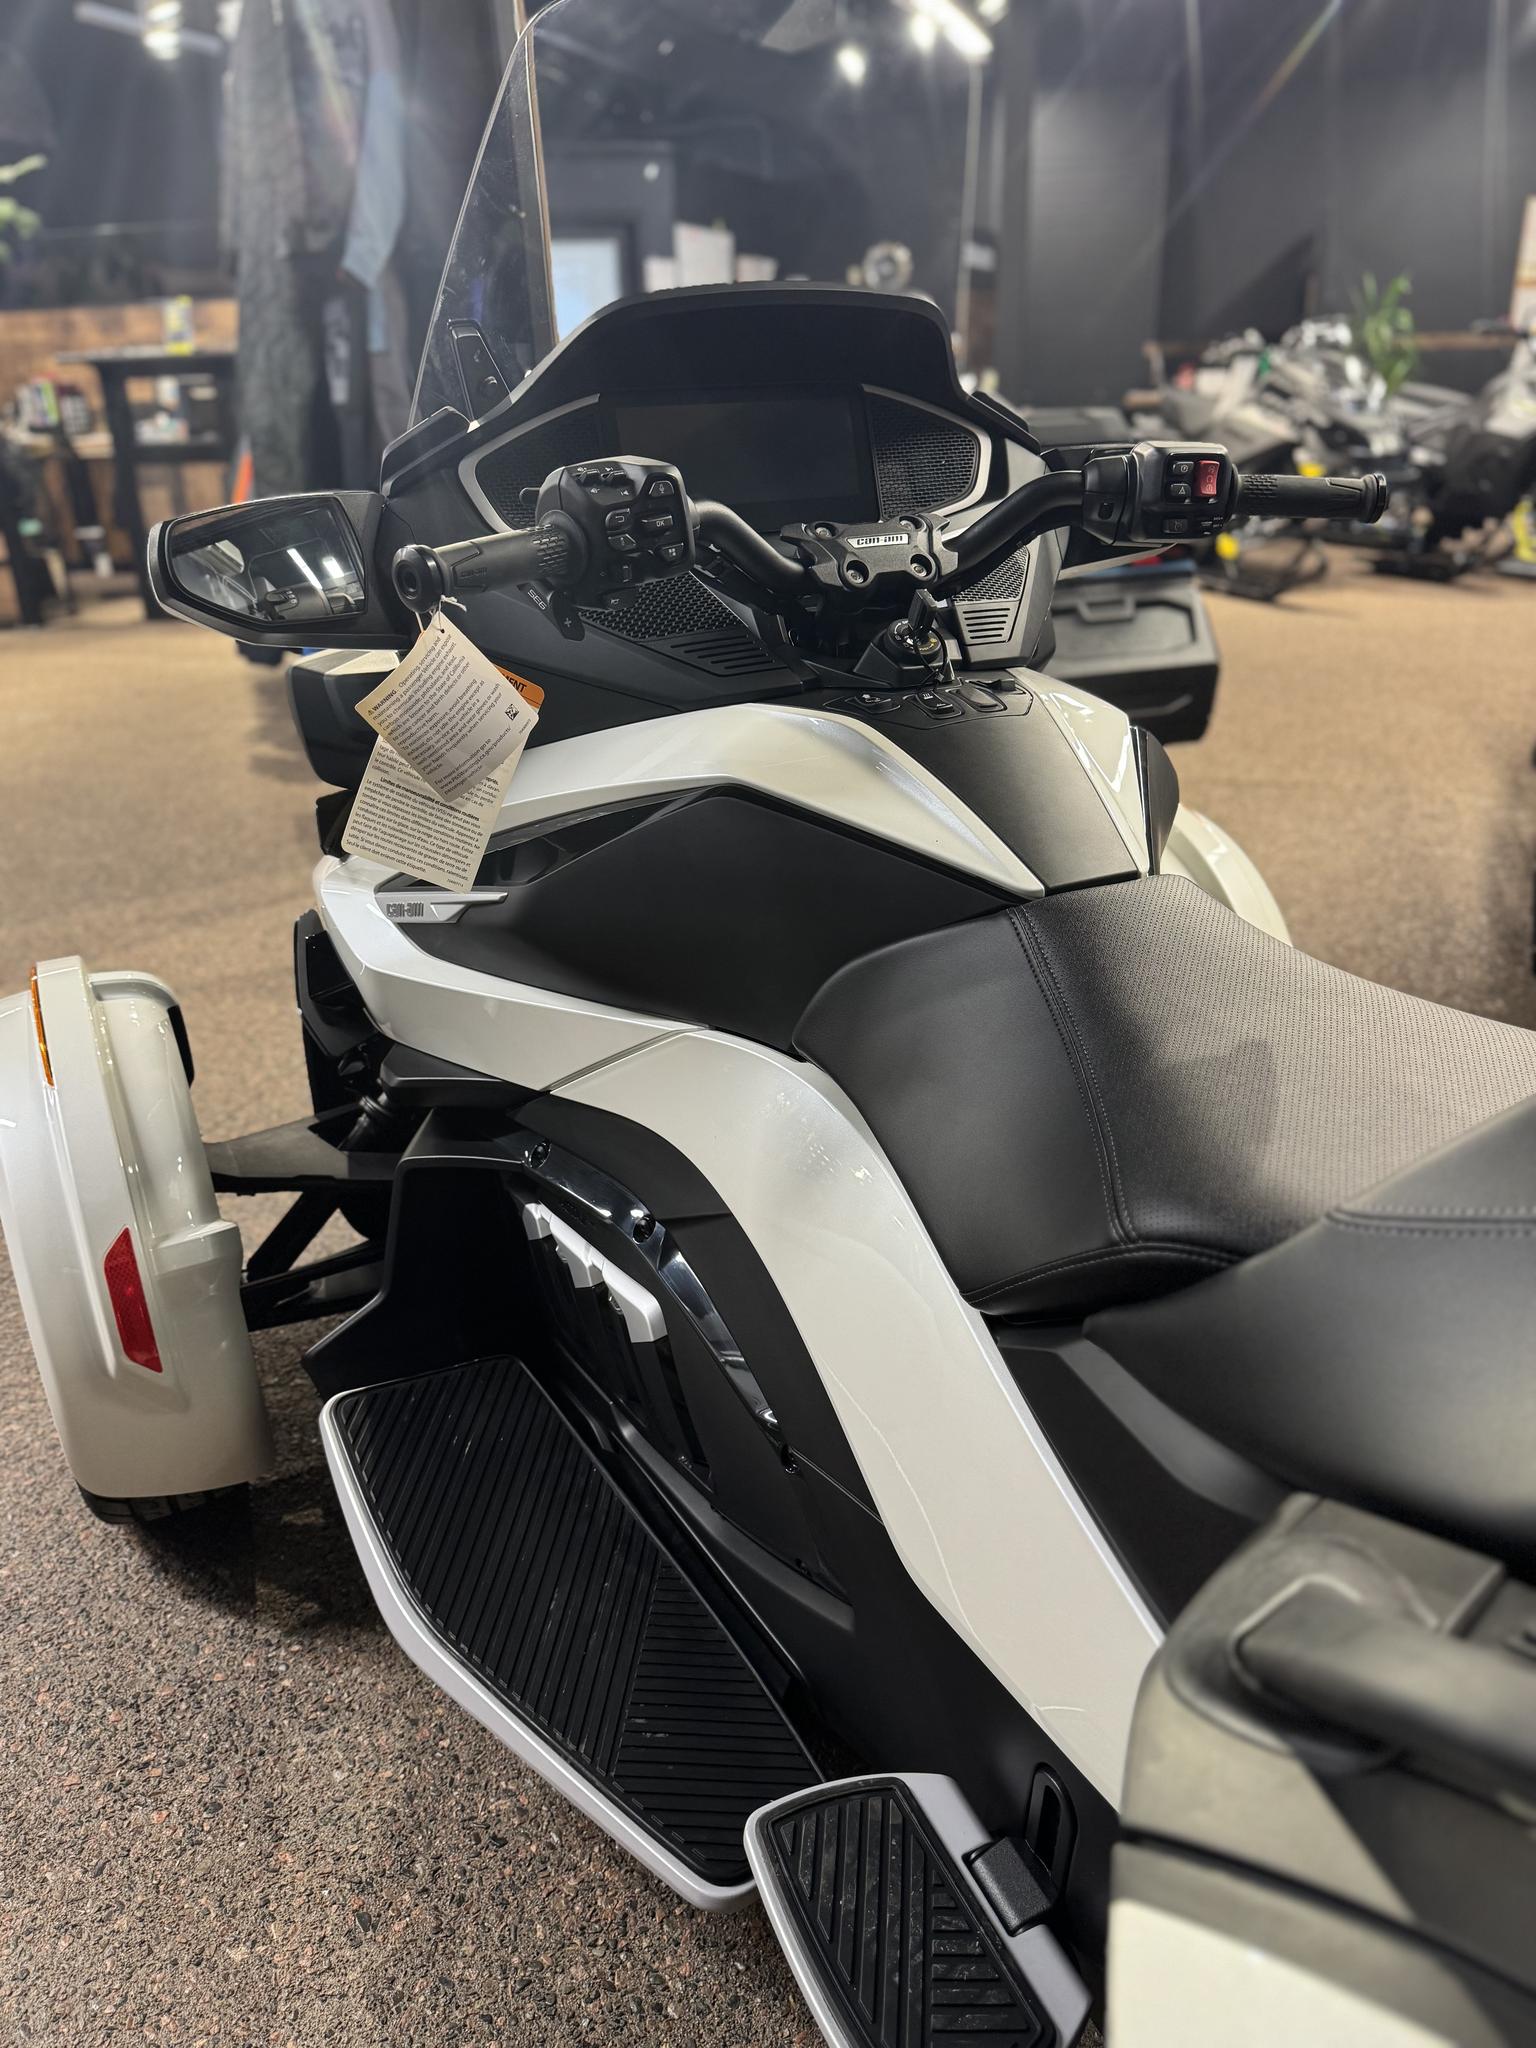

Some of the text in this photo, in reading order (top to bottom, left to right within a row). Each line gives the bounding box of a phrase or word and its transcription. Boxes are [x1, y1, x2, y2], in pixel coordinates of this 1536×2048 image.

[856, 535, 903, 546] can-am
[527, 589, 548, 610] SE6
[386, 902, 424, 917] can-am
